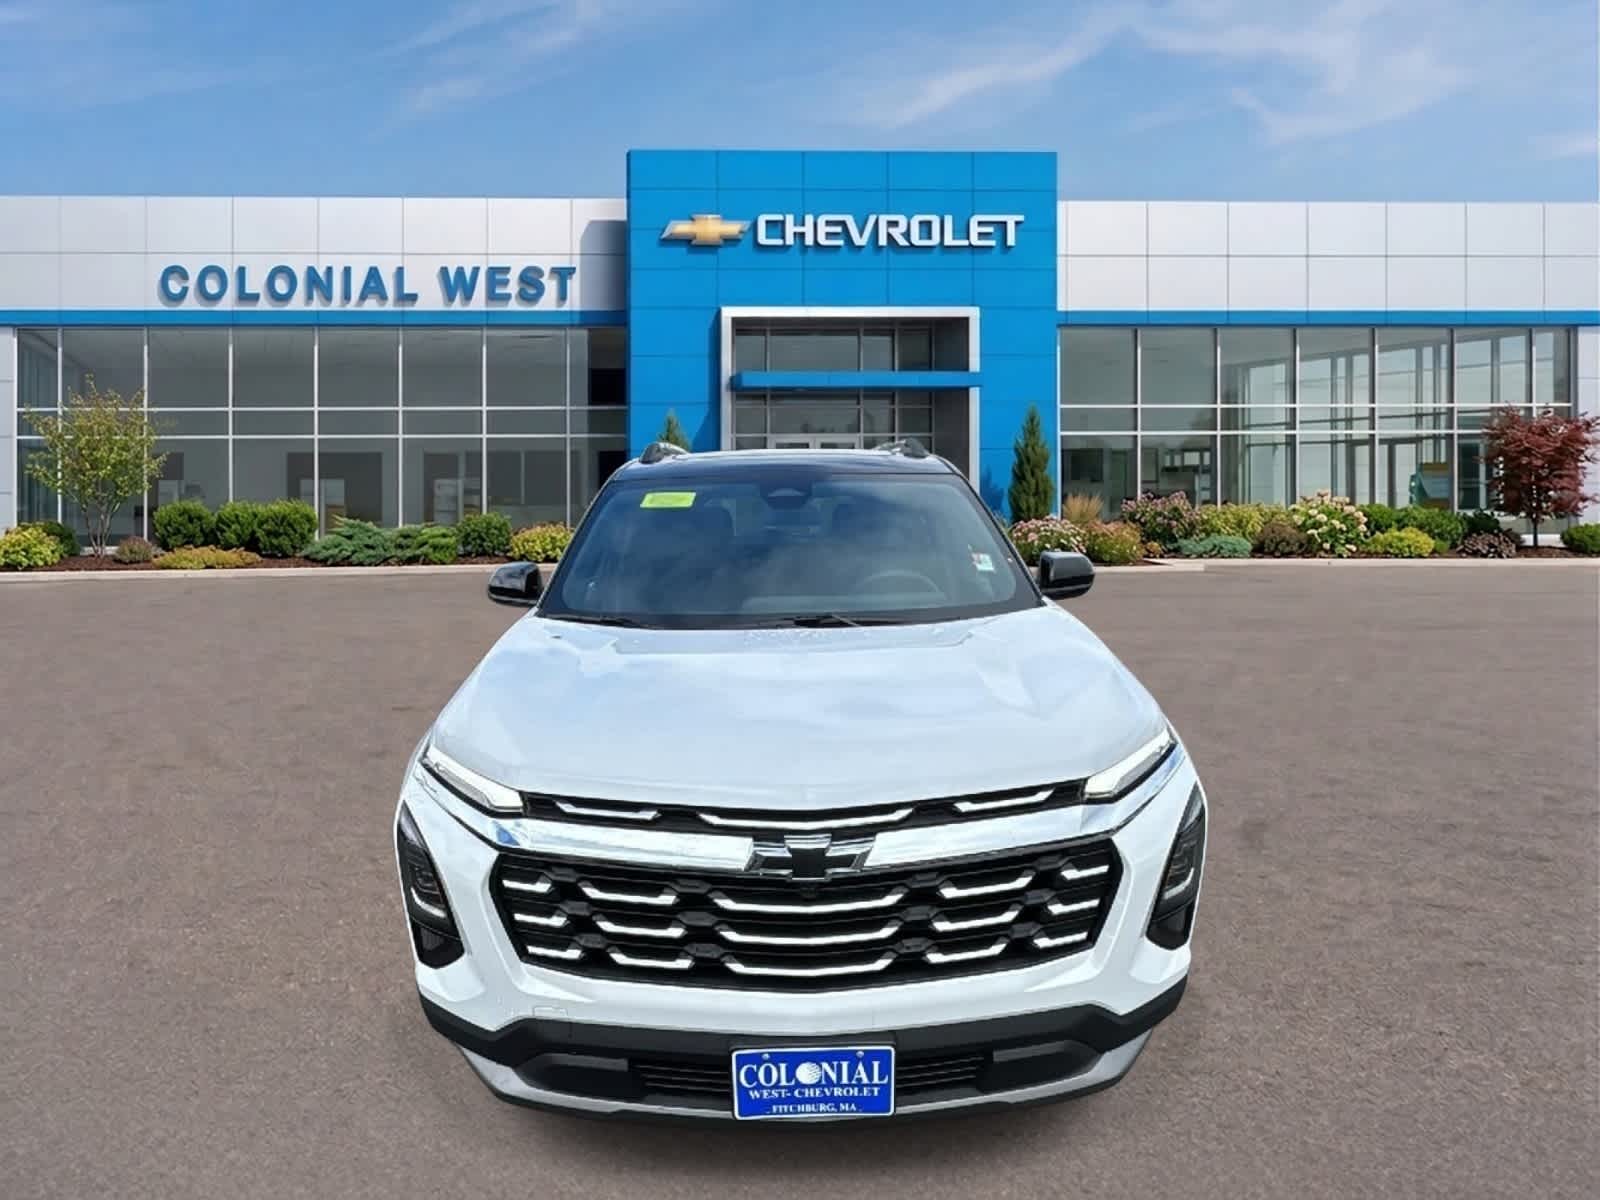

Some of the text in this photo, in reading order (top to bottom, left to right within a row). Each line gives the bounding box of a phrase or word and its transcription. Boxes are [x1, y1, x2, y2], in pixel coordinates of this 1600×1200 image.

[757, 214, 1025, 247] CHEVROLET
[160, 265, 577, 305] COLONIAL WEST
[739, 1060, 889, 1088] COLONIAL
[793, 1086, 880, 1098] CHEVROLET
[839, 1102, 857, 1112] MA
